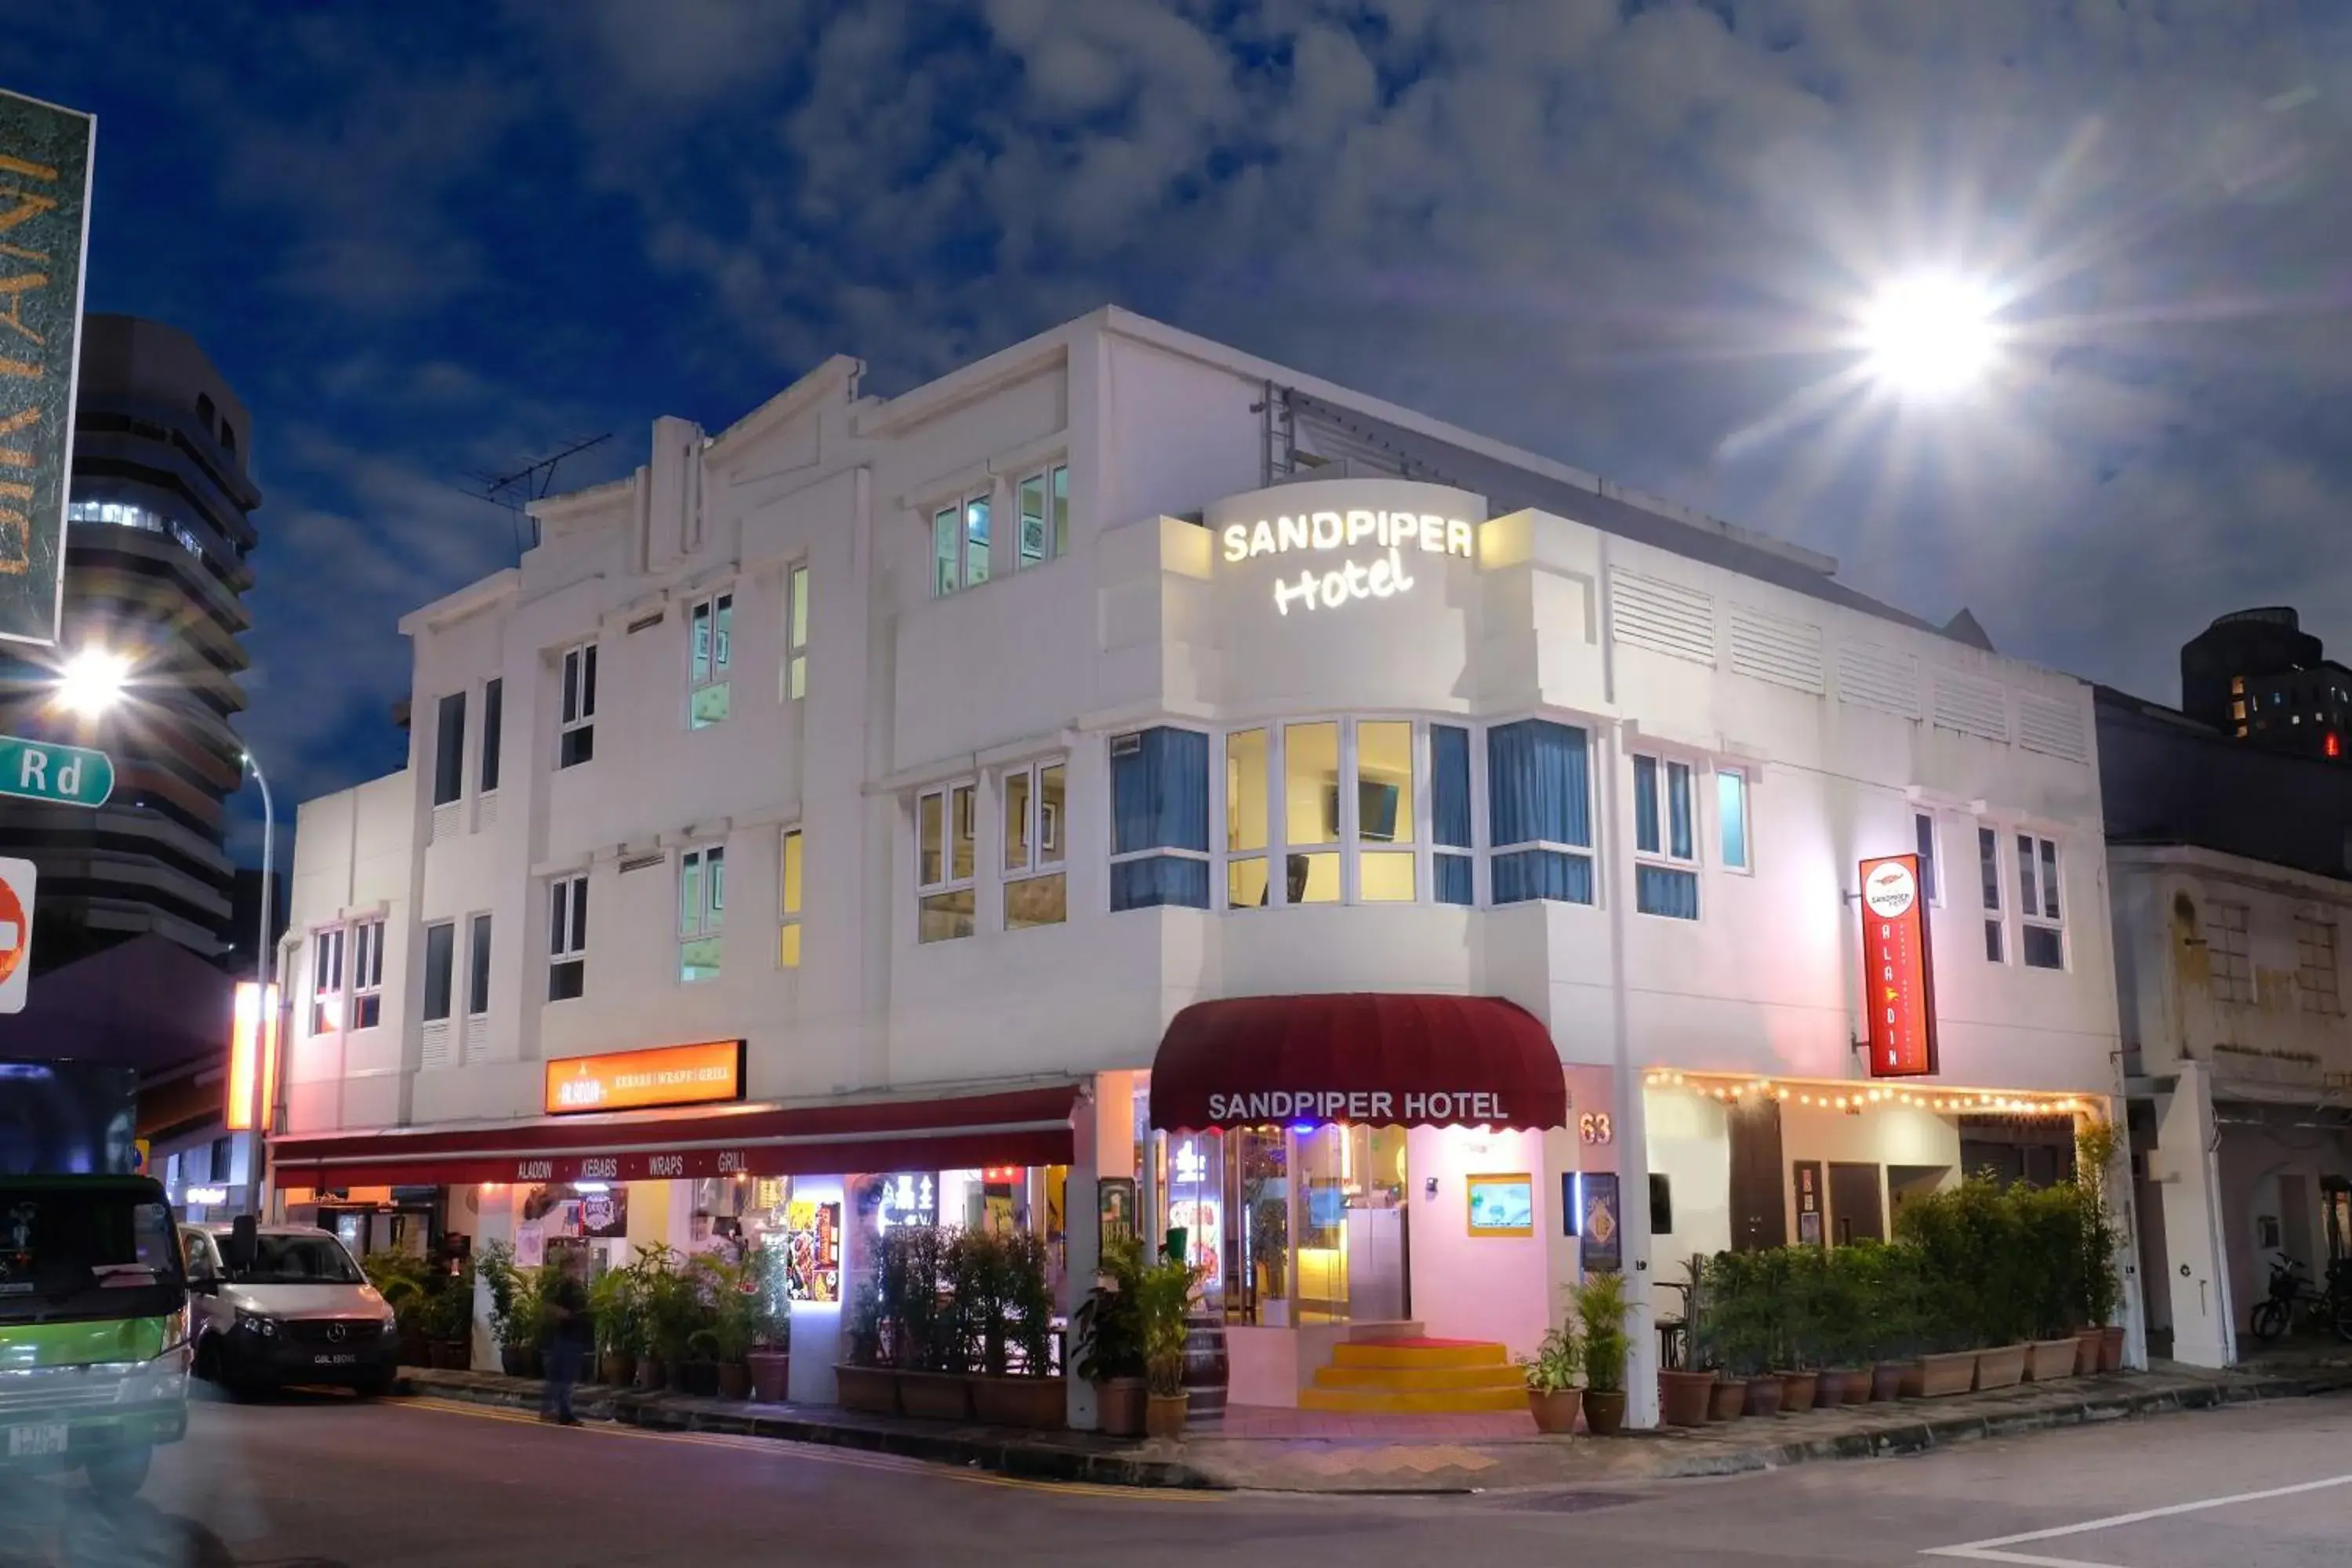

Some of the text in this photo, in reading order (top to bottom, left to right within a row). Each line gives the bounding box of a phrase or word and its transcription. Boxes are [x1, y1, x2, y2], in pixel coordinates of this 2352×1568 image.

[1223, 510, 1472, 562] SANDPIPER
[20, 749, 82, 795] Rd
[615, 1065, 730, 1088] KEBABS WRAPS GRILL
[1208, 1091, 1509, 1120] SANDPIPER HOTEL
[1579, 1112, 1611, 1145] 63
[517, 1152, 747, 1179] ALADDIN KEBABS WRAPS GRILL
